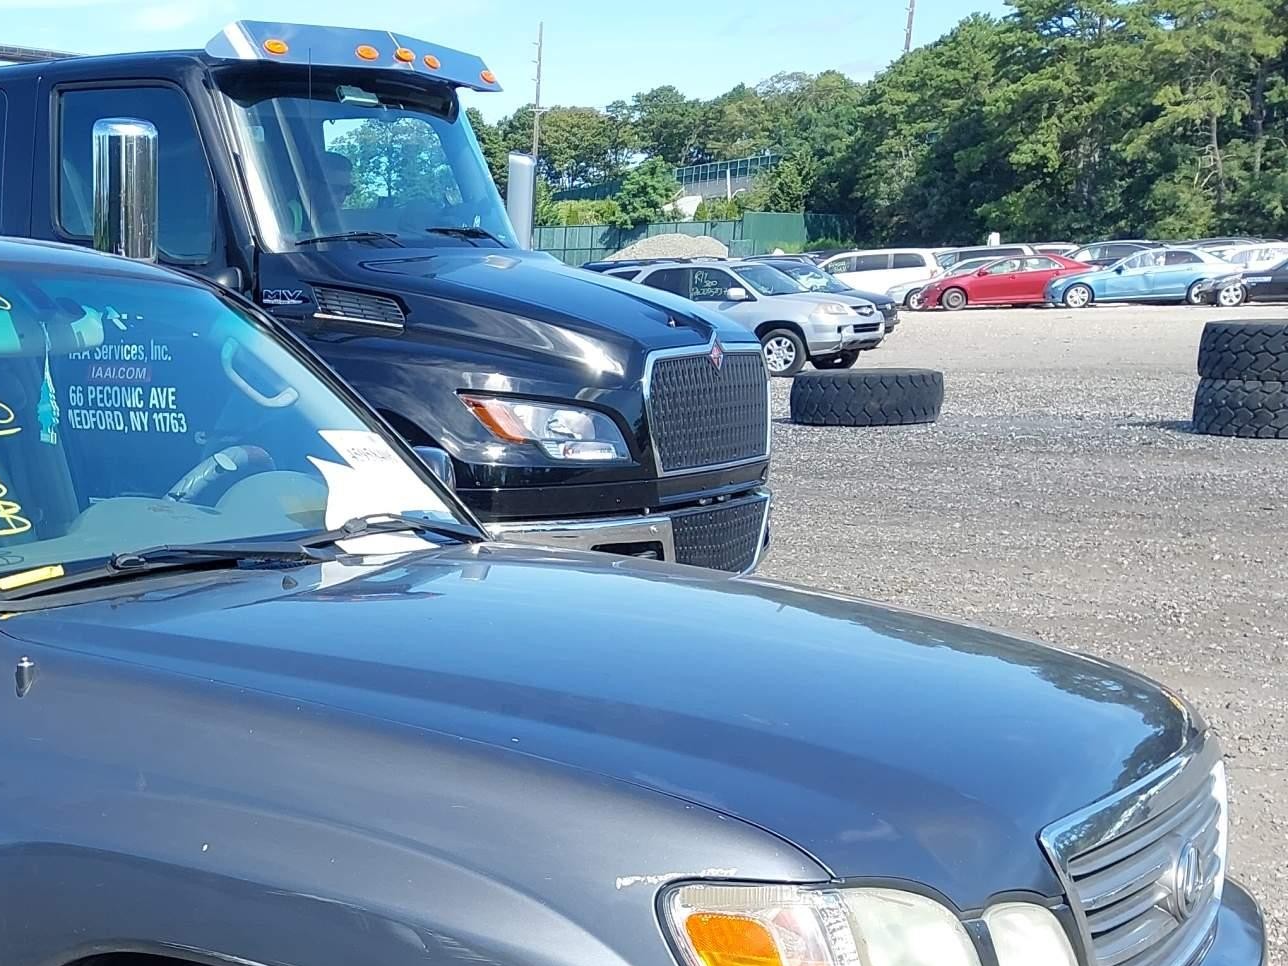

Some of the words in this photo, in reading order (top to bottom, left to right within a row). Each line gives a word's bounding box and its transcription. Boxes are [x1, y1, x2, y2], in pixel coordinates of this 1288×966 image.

[94, 339, 148, 363] Services,
[150, 339, 172, 361] Inc.
[91, 366, 147, 379] IAAI.COM
[69, 385, 84, 406] 66
[87, 386, 144, 408] PECONIC
[149, 387, 177, 409] AVE
[129, 410, 149, 432] NY
[152, 411, 187, 433] 11763
